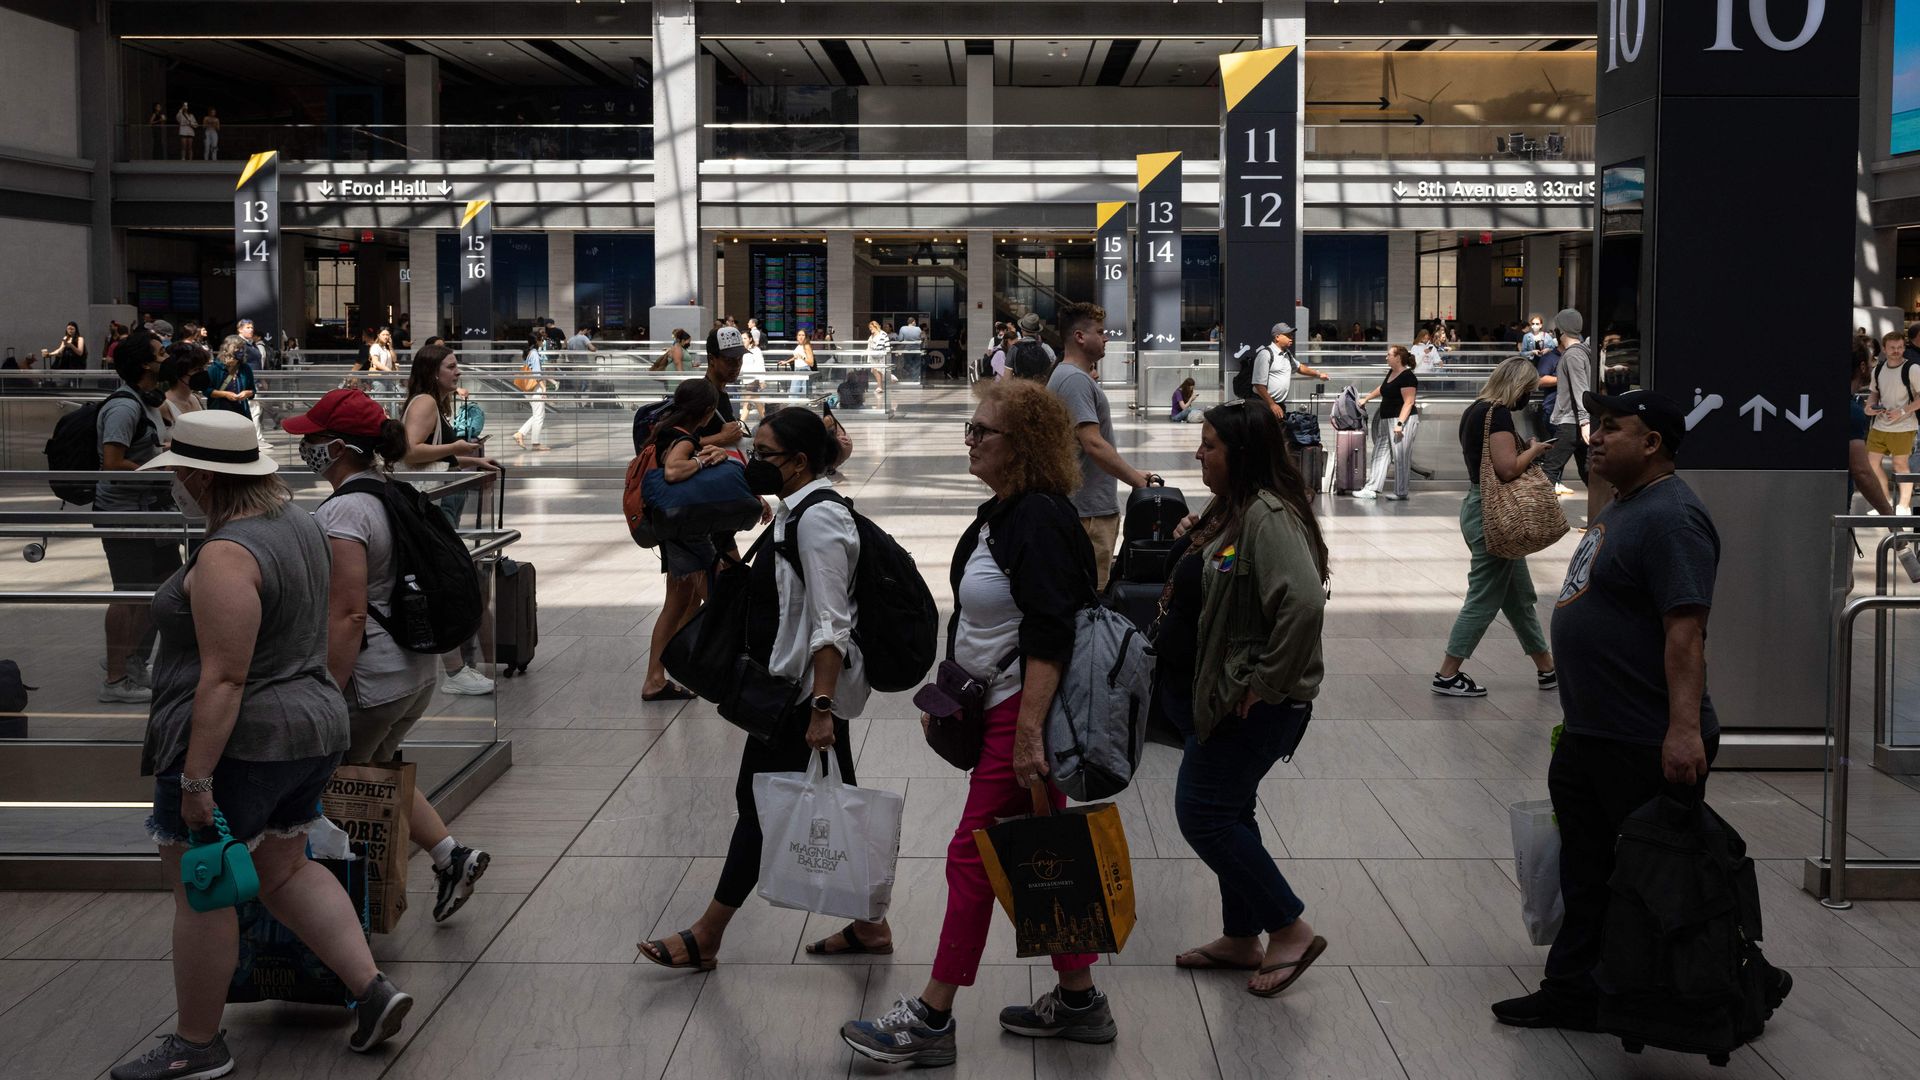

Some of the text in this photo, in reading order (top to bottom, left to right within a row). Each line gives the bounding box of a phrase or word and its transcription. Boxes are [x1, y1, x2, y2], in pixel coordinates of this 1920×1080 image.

[1243, 128, 1279, 163] 11
[341, 179, 428, 197] Food Hall
[1417, 181, 1446, 197] 8th
[1451, 181, 1518, 197] Avenue
[1523, 181, 1537, 197] &
[1543, 181, 1583, 197] 33rd
[243, 200, 269, 223] 13
[1149, 201, 1174, 224] 13
[1241, 192, 1282, 228] 12
[243, 239, 270, 263] 14
[467, 235, 485, 251] 15
[1104, 236, 1122, 253] 15
[1148, 240, 1175, 263] 14
[467, 262, 486, 279] 16
[1104, 263, 1123, 281] 16
[789, 841, 849, 862] MAGNOLIA
[797, 854, 839, 872] BAKERY
